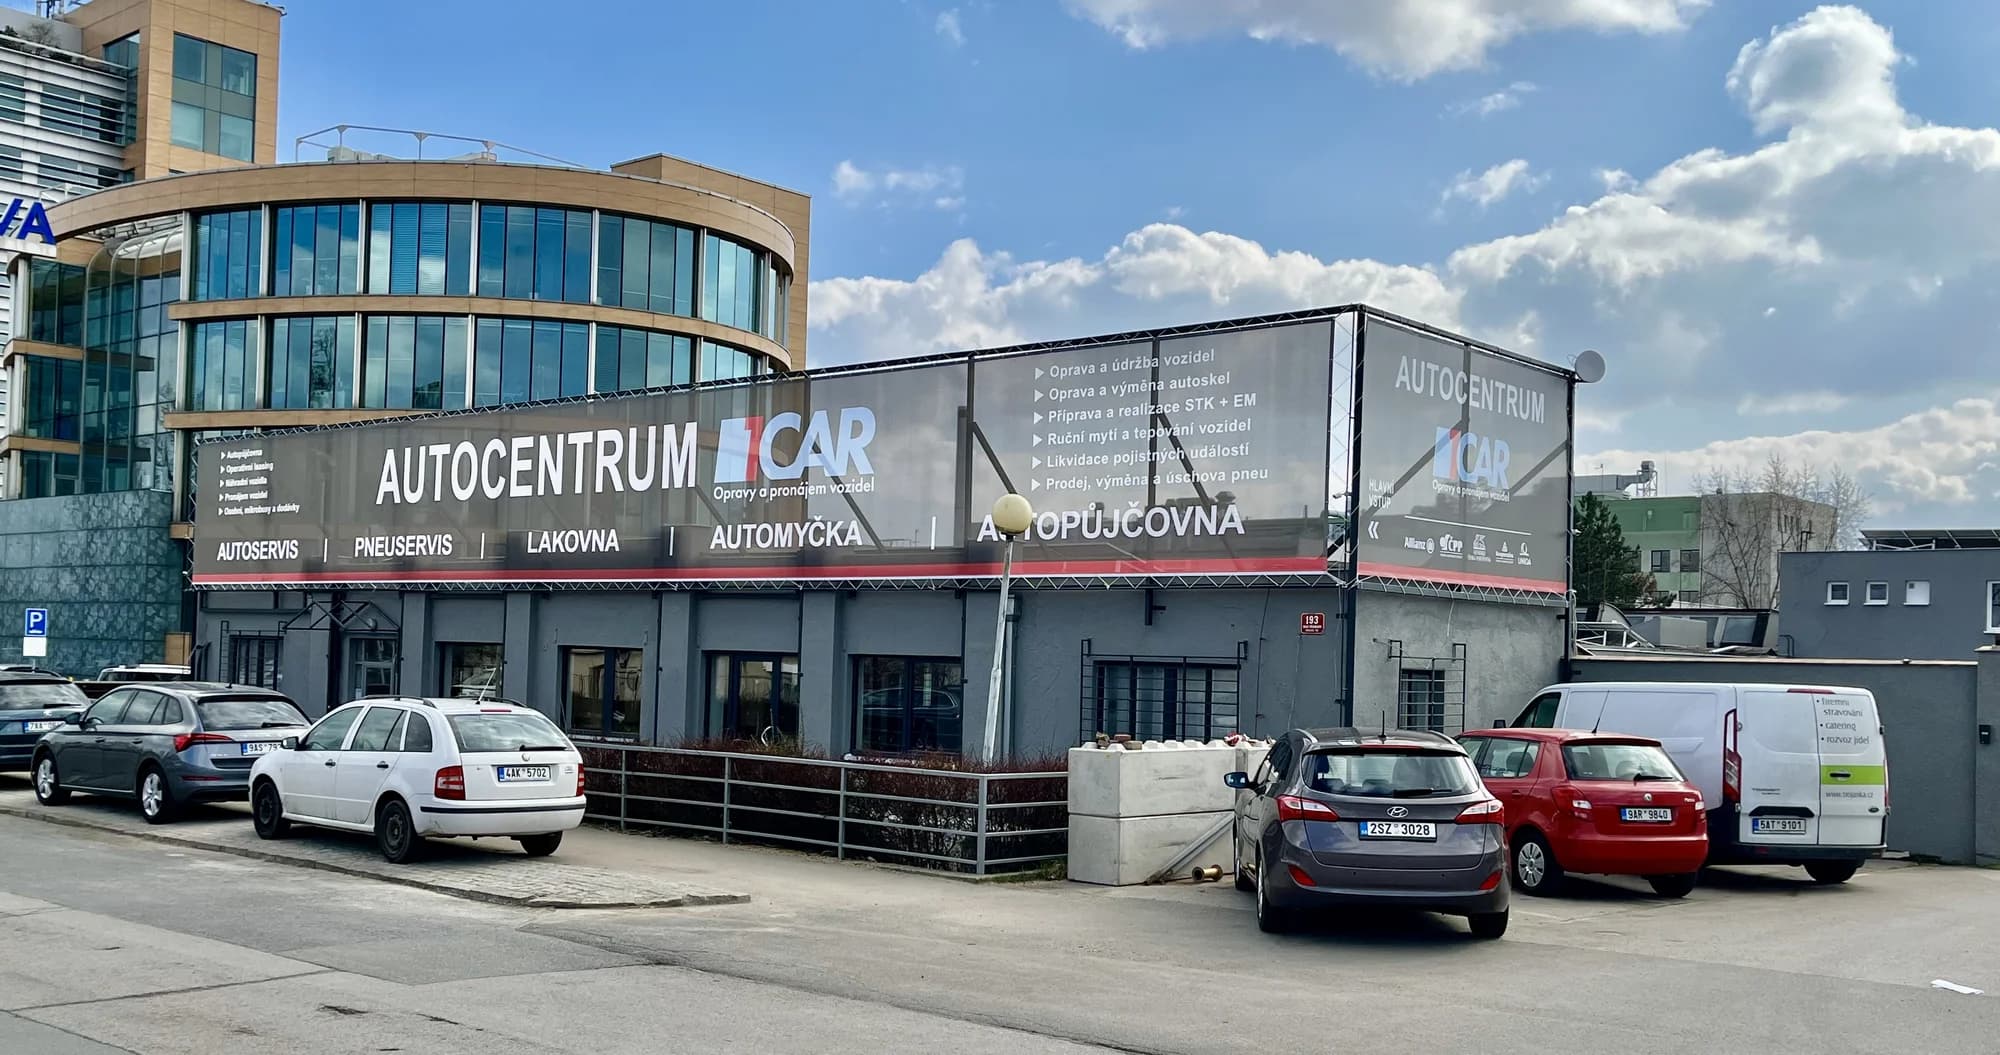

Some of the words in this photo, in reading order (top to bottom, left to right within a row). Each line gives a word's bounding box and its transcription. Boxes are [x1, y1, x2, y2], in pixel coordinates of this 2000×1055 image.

[1050, 363, 1096, 380] Oprava
[1100, 364, 1107, 374] a
[1112, 355, 1159, 372] údržba
[1164, 349, 1215, 366] vozidel
[1049, 386, 1095, 402] Oprava
[1099, 387, 1107, 396] a
[1111, 378, 1164, 397] výměna
[1169, 371, 1230, 389] autoskel
[1395, 355, 1545, 424] AUTOCENTRUM
[1048, 408, 1102, 424] Příprava
[1107, 409, 1114, 418] a
[1118, 402, 1180, 417] realizace
[1185, 398, 1215, 412] STK
[1234, 393, 1256, 408] EM
[1047, 430, 1084, 446] Ruční
[1089, 427, 1118, 446] mytí
[1122, 431, 1129, 440] a
[1134, 422, 1194, 442] tepování
[1199, 418, 1252, 434] vozidel
[375, 421, 698, 505] AUTOCENTRUM
[1047, 453, 1109, 468] Likvidace
[1113, 448, 1185, 467] pojistných
[1190, 443, 1250, 459] událostí
[713, 486, 756, 503] Opravy
[759, 487, 767, 498] a
[770, 481, 827, 501] pronájem
[830, 477, 875, 495] vozidel
[1046, 475, 1091, 491] Prodej,
[1096, 471, 1149, 490] výměna
[1153, 475, 1161, 484] a
[1166, 468, 1226, 484] úschova
[1231, 467, 1268, 483] pneu
[710, 515, 863, 550] AUTOMYČKA
[976, 501, 1245, 542] AOPŮJČOVNA
[216, 539, 299, 561] AUTOSERVIS
[354, 534, 453, 558] PNEUSERVIS
[527, 529, 619, 554] LAKOVNA
[30, 612, 43, 628] P
[1305, 615, 1319, 625] 193
[506, 767, 521, 778] 4AK
[526, 767, 547, 778] 5702
[1627, 809, 1643, 819] 9AR
[1648, 809, 1668, 819] 9840
[1760, 820, 1776, 830] 5AT
[1781, 820, 1802, 830] 9101
[1370, 822, 1392, 835] 2SZ
[1401, 823, 1430, 836] 3028
